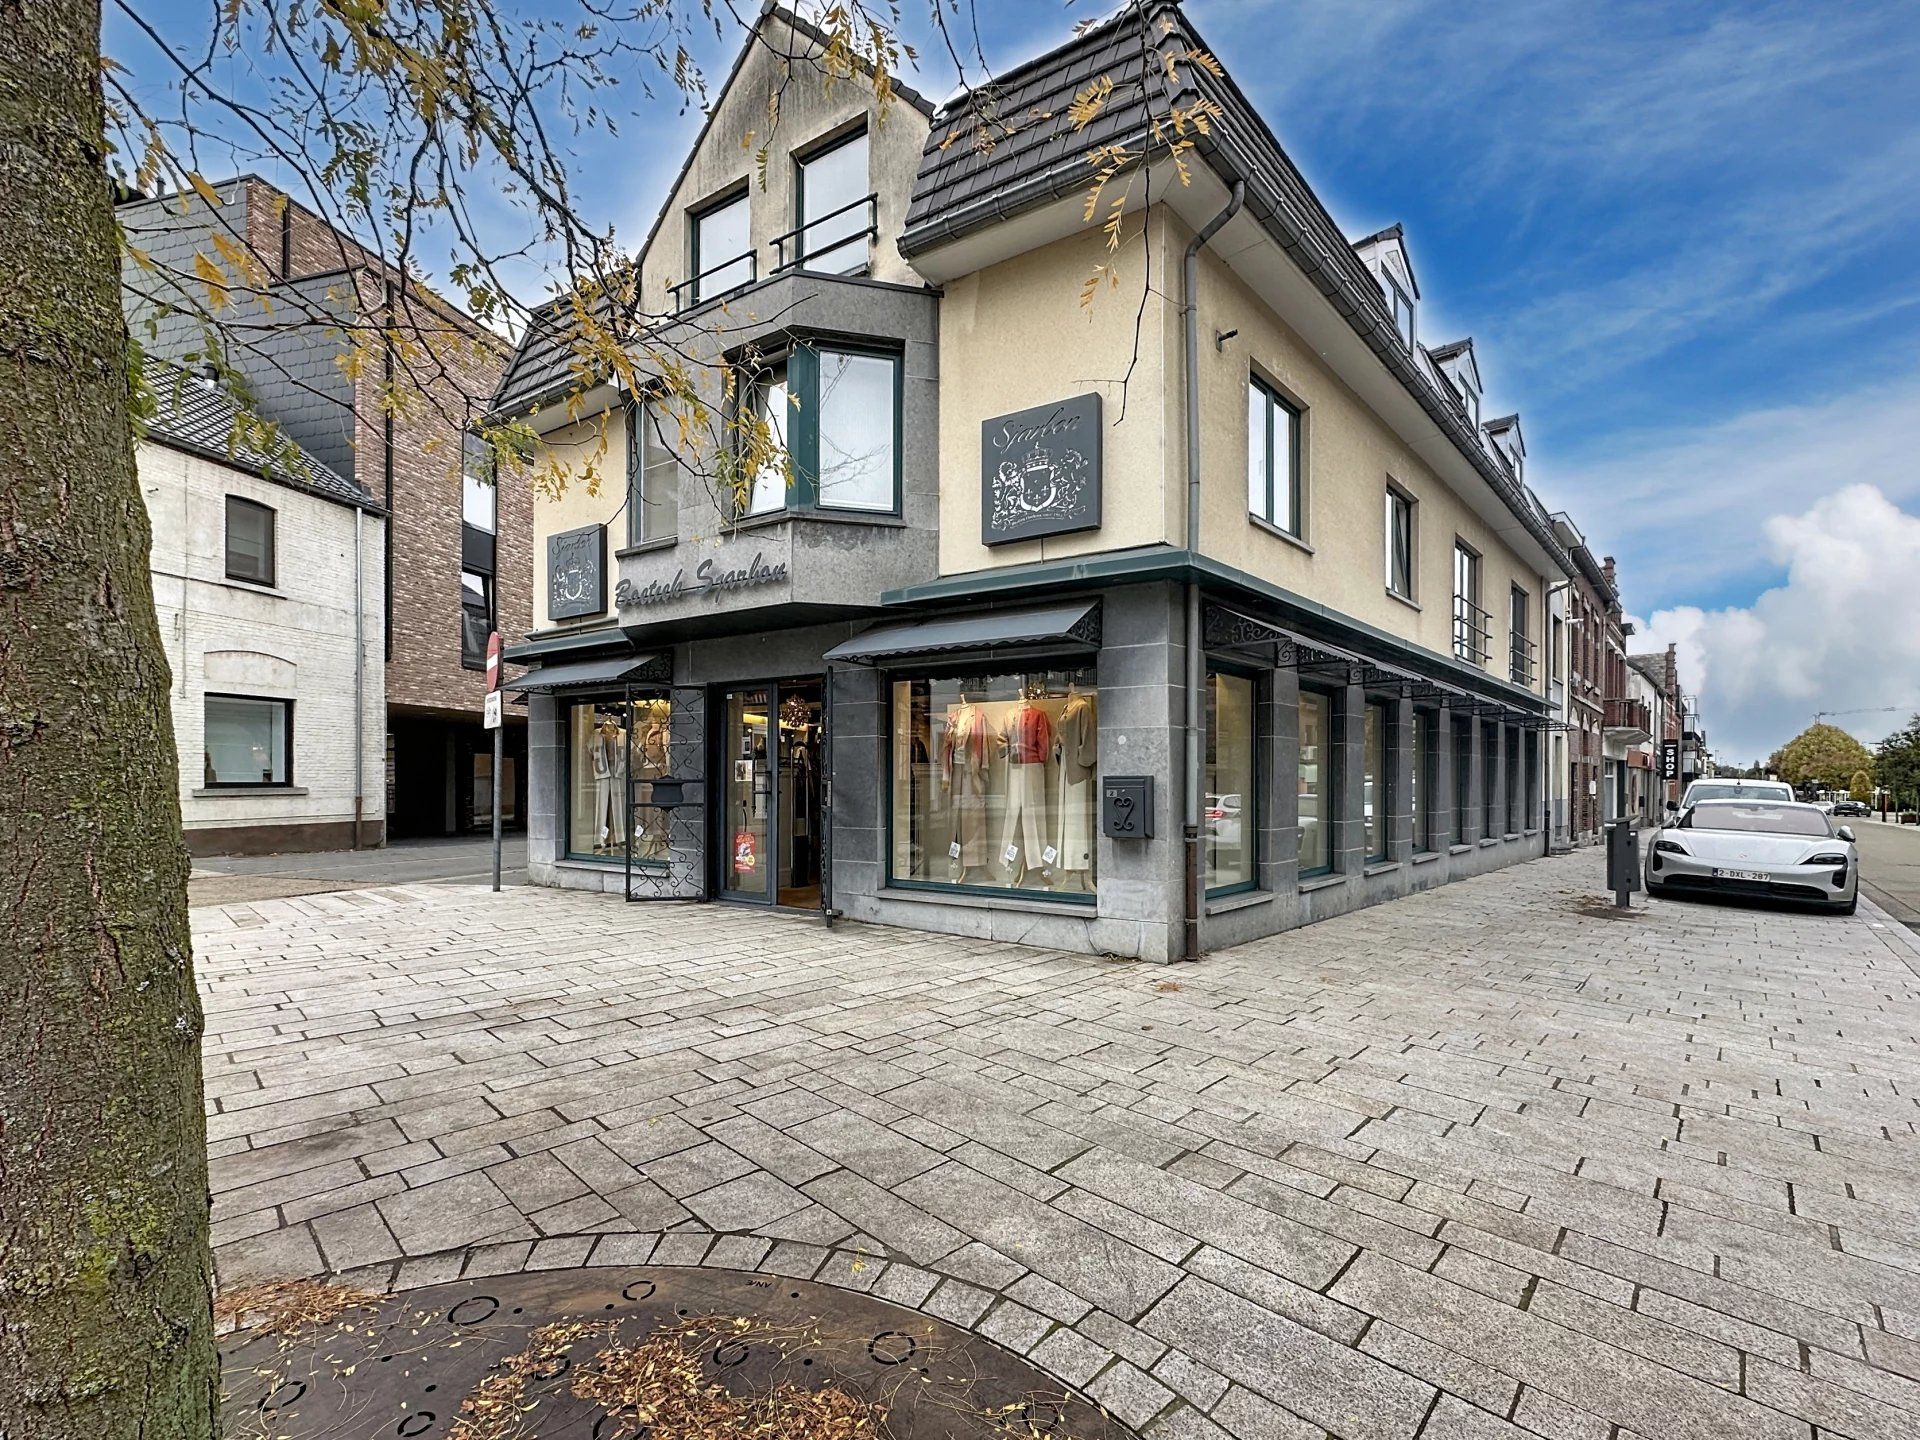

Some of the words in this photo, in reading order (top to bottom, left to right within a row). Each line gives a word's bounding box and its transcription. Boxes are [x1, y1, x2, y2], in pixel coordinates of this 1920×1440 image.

[992, 407, 1081, 454] Sjarbon
[615, 569, 683, 609] Boetiek
[697, 552, 788, 603] Sjarbon
[1665, 748, 1675, 777] SHOP
